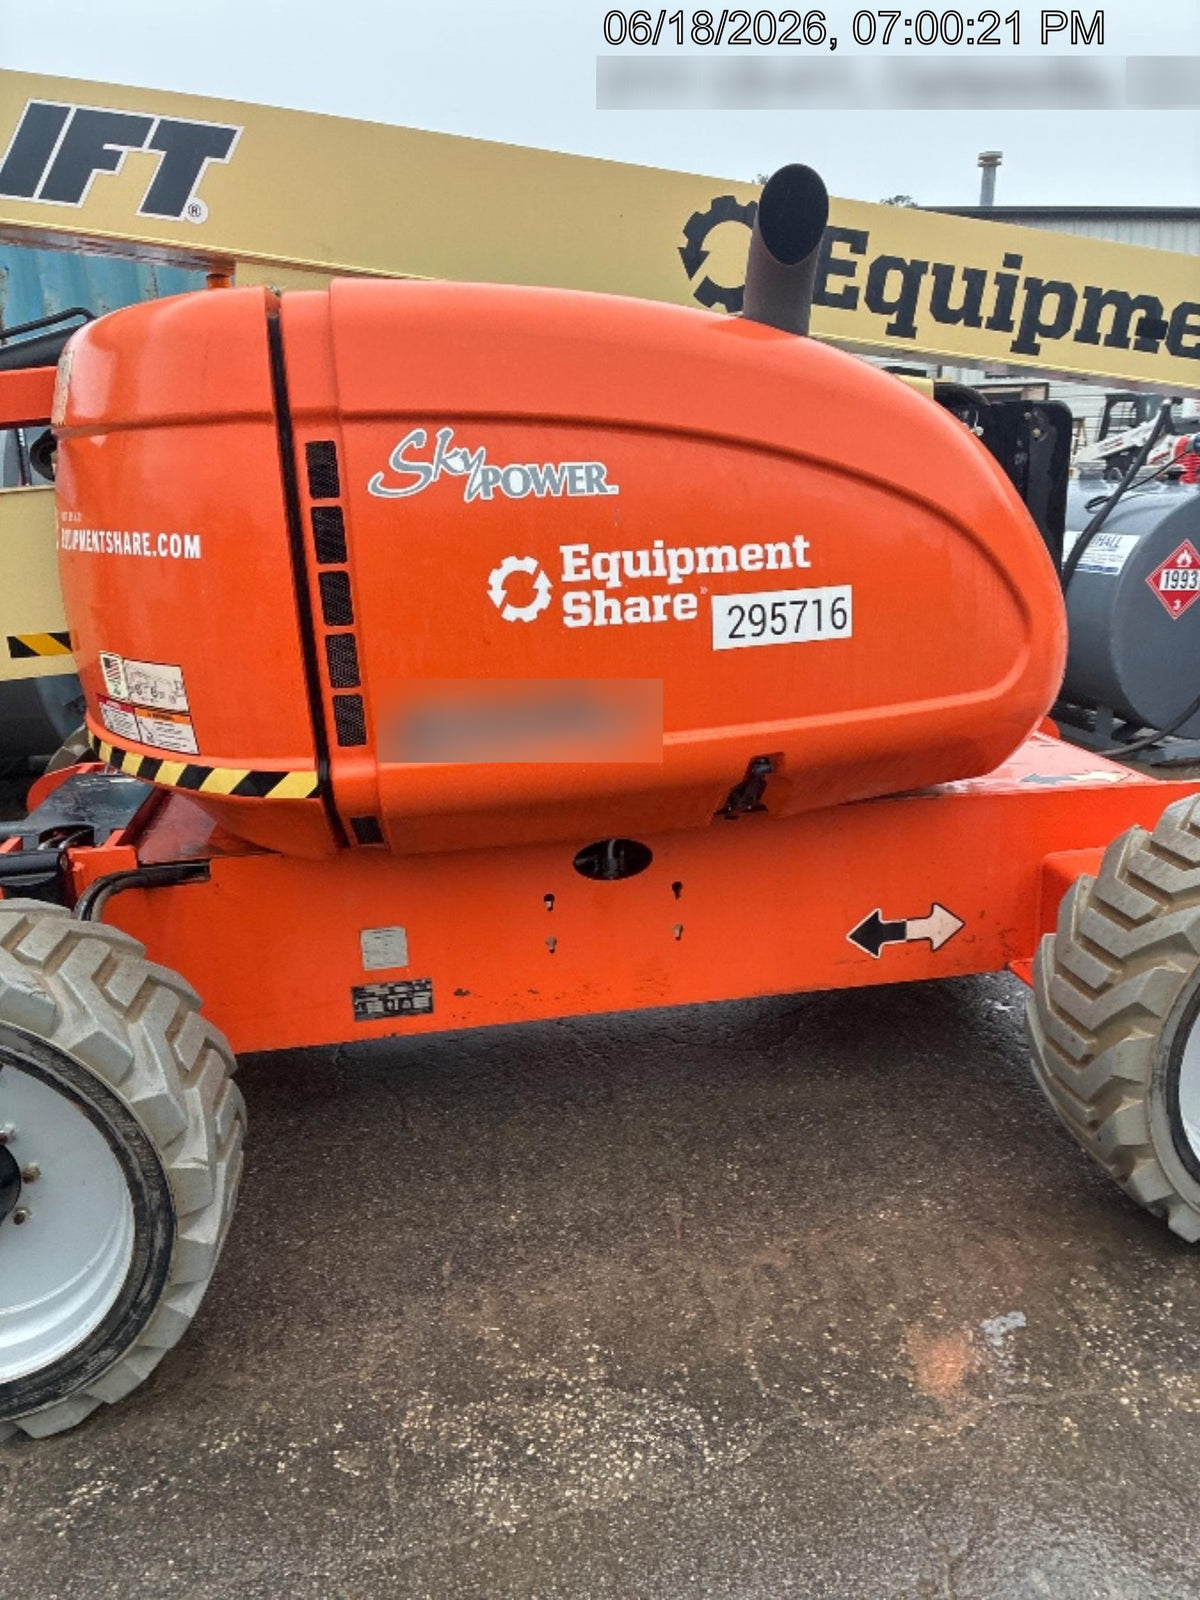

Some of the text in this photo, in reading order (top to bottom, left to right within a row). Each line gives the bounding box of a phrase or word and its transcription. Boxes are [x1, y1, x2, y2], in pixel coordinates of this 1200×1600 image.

[560, 535, 811, 588] Equipment
[1164, 570, 1199, 590] 1993
[562, 589, 698, 628] Share
[727, 597, 848, 640] 295716
[1173, 599, 1182, 611] 3
